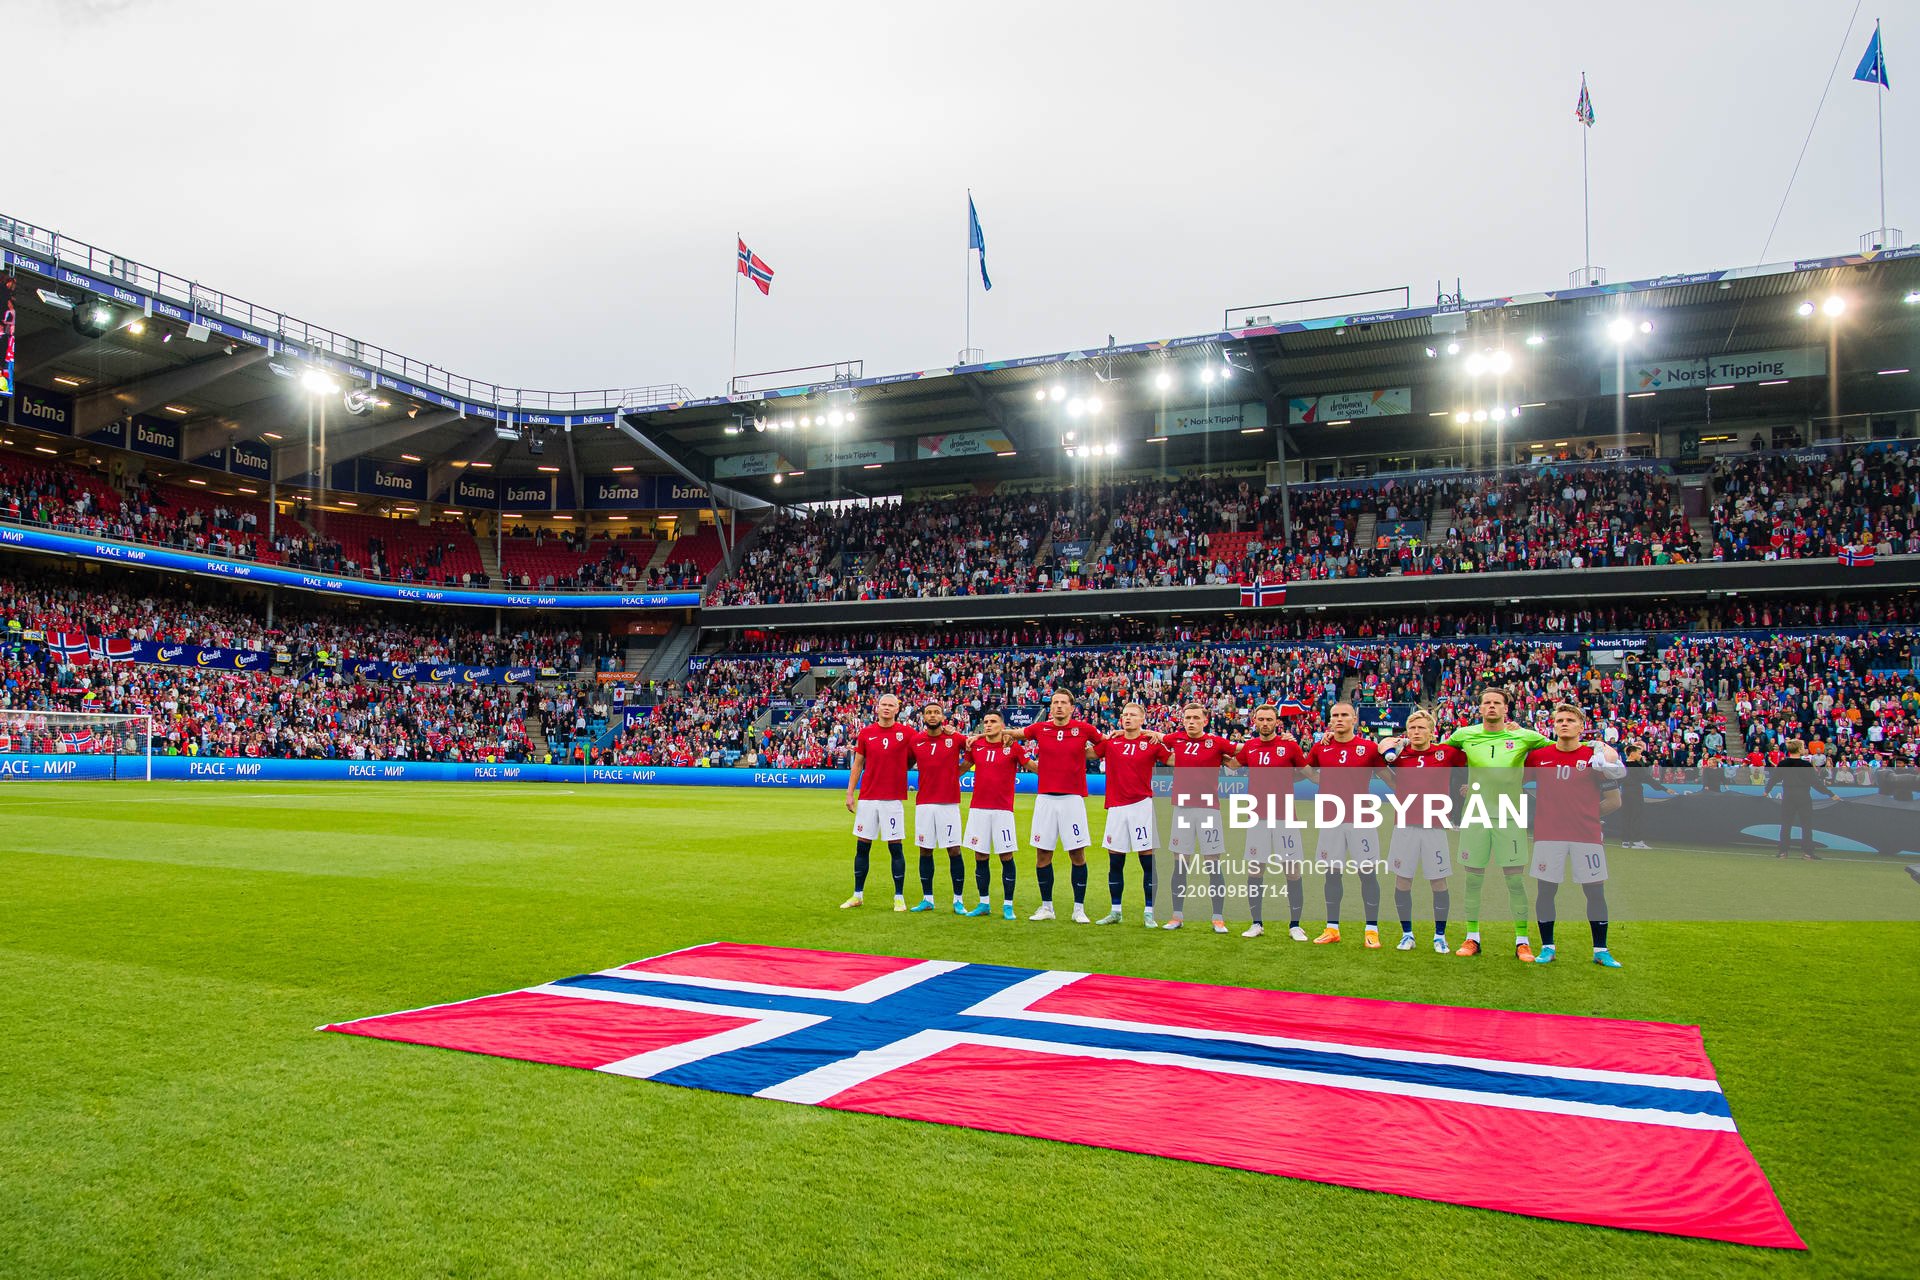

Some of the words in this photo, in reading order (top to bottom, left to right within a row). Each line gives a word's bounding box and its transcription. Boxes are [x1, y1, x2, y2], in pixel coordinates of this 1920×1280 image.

[14, 255, 39, 271] bama
[66, 272, 90, 288] bama
[114, 288, 137, 304] bama
[160, 304, 181, 318] bama
[202, 317, 222, 332] bama
[242, 330, 262, 344] bama
[1667, 366, 1716, 382] Norsk
[1720, 361, 1784, 378] Tipping
[381, 375, 398, 389] bama
[411, 386, 427, 399] bama
[22, 395, 65, 423] bama
[440, 396, 456, 409] bama
[477, 407, 495, 418] bama
[529, 414, 550, 425] bama
[583, 414, 604, 425] bama
[1190, 415, 1213, 427] Norsk
[1214, 413, 1244, 425] Tipping
[138, 424, 175, 448] bama
[235, 448, 268, 470] bama
[375, 470, 412, 489] bama
[459, 481, 495, 500] bama
[507, 486, 546, 501] bama
[599, 484, 639, 500] bama
[3, 531, 24, 542] МИР
[96, 545, 121, 557] PEACE
[128, 550, 146, 560] МИР
[207, 562, 228, 572] PEACE
[235, 566, 251, 576] МИР
[303, 577, 322, 586] PEACE
[327, 580, 343, 589] МИР
[398, 589, 420, 598] PEACE
[426, 591, 443, 600] МИР
[507, 596, 531, 604] PEACE
[538, 597, 556, 605] МИР
[621, 597, 644, 605] PEACE
[651, 597, 669, 605] МИР
[1597, 639, 1621, 647] Norsk
[1622, 638, 1647, 648] Tippin
[1688, 637, 1714, 645] Norsk
[163, 646, 183, 658] Bendit
[203, 649, 222, 661] Bendit
[240, 653, 258, 665] Bendit
[359, 663, 377, 674] Bendit
[398, 665, 418, 677] Bendit
[436, 666, 457, 678] Bendit
[469, 668, 490, 679] Bendit
[509, 669, 531, 681] Bendit
[1057, 730, 1064, 742] 8
[882, 737, 889, 750] 9
[930, 743, 937, 755] 7
[1123, 743, 1136, 756] 21
[1184, 741, 1200, 756] 22
[986, 750, 996, 762] 11
[1258, 751, 1270, 765] 16
[1339, 750, 1347, 764] 3
[1490, 745, 1495, 759] 1
[0, 760, 30, 774] ACE
[44, 760, 77, 774] МИР
[1416, 755, 1424, 768] 5
[190, 762, 225, 775] PEACE
[236, 763, 261, 775] МИР
[349, 765, 376, 776] PEACE
[384, 766, 405, 776] МИР
[474, 767, 497, 778] PEACE
[503, 767, 521, 777] МИР
[593, 769, 623, 780] PEACE
[633, 770, 656, 780] МИР
[1556, 764, 1571, 780] 10
[755, 773, 789, 784] PEACE
[800, 773, 826, 784] МИР
[890, 817, 896, 830] 9
[1072, 823, 1080, 836] 8
[947, 825, 953, 837] 7
[1001, 829, 1011, 842] 11
[1136, 826, 1148, 840] 21
[1205, 829, 1220, 843] 22
[1282, 835, 1294, 849] 16
[1361, 838, 1370, 853] 3
[1512, 839, 1518, 854] 1
[1435, 850, 1443, 865] 5
[1585, 853, 1601, 870] 10
